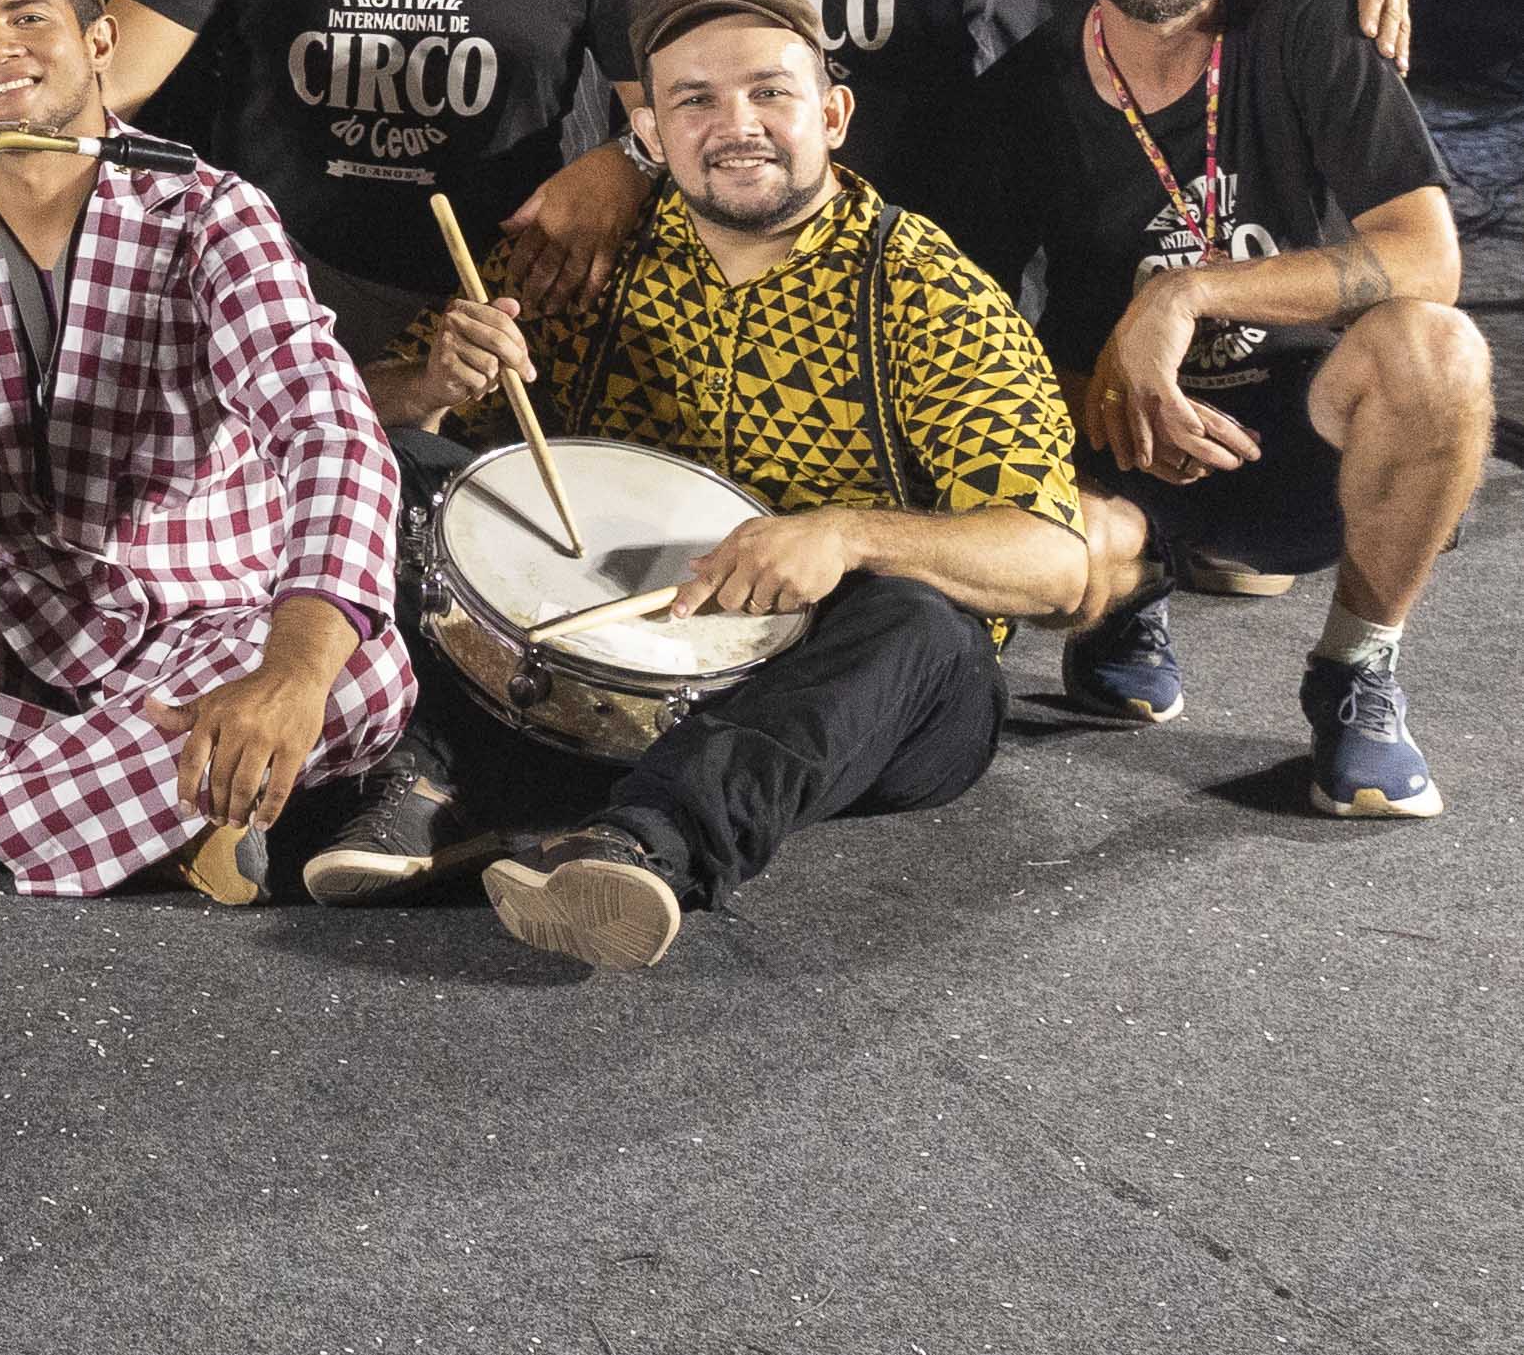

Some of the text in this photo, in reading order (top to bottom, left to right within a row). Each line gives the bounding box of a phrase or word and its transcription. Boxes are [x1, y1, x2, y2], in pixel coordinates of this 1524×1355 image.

[328, 8, 470, 34] INTERNACIONAL DE
[288, 31, 498, 117] CIRCO
[331, 115, 448, 159] do Ceará
